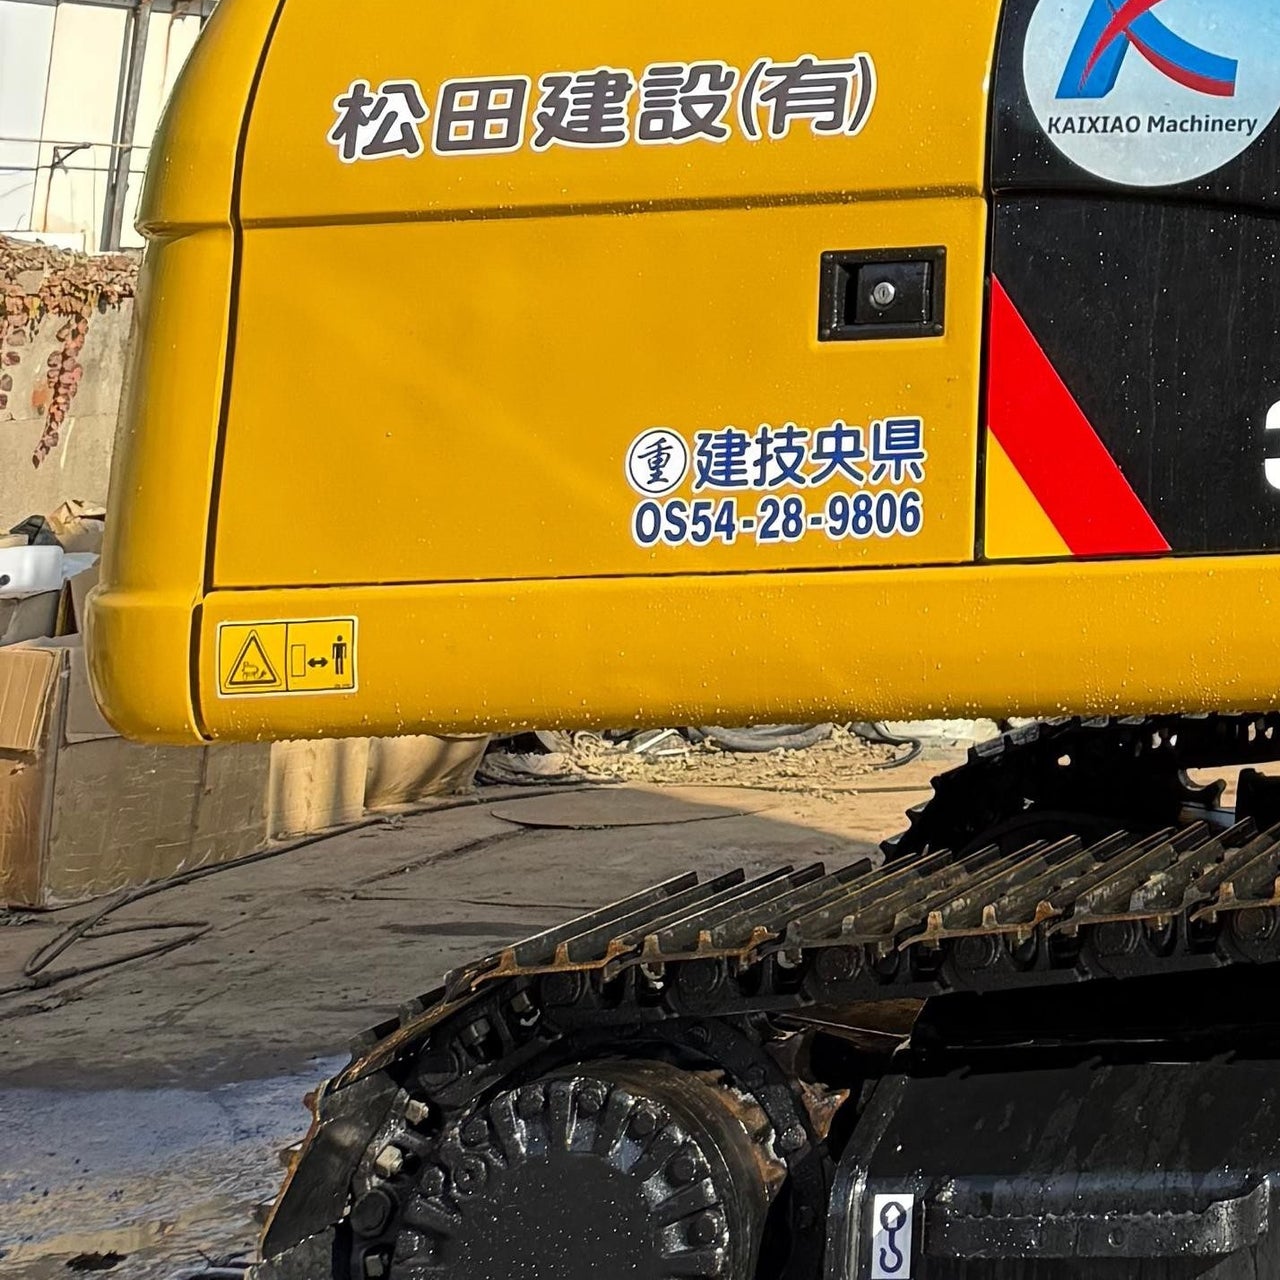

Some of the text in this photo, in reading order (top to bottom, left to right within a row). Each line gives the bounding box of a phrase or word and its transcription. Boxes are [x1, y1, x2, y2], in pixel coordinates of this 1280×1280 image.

[330, 54, 874, 161] 松田建設(有)
[1047, 114, 1258, 137] KAIXIAO Machinery
[635, 490, 922, 544] OS54-28-9806
